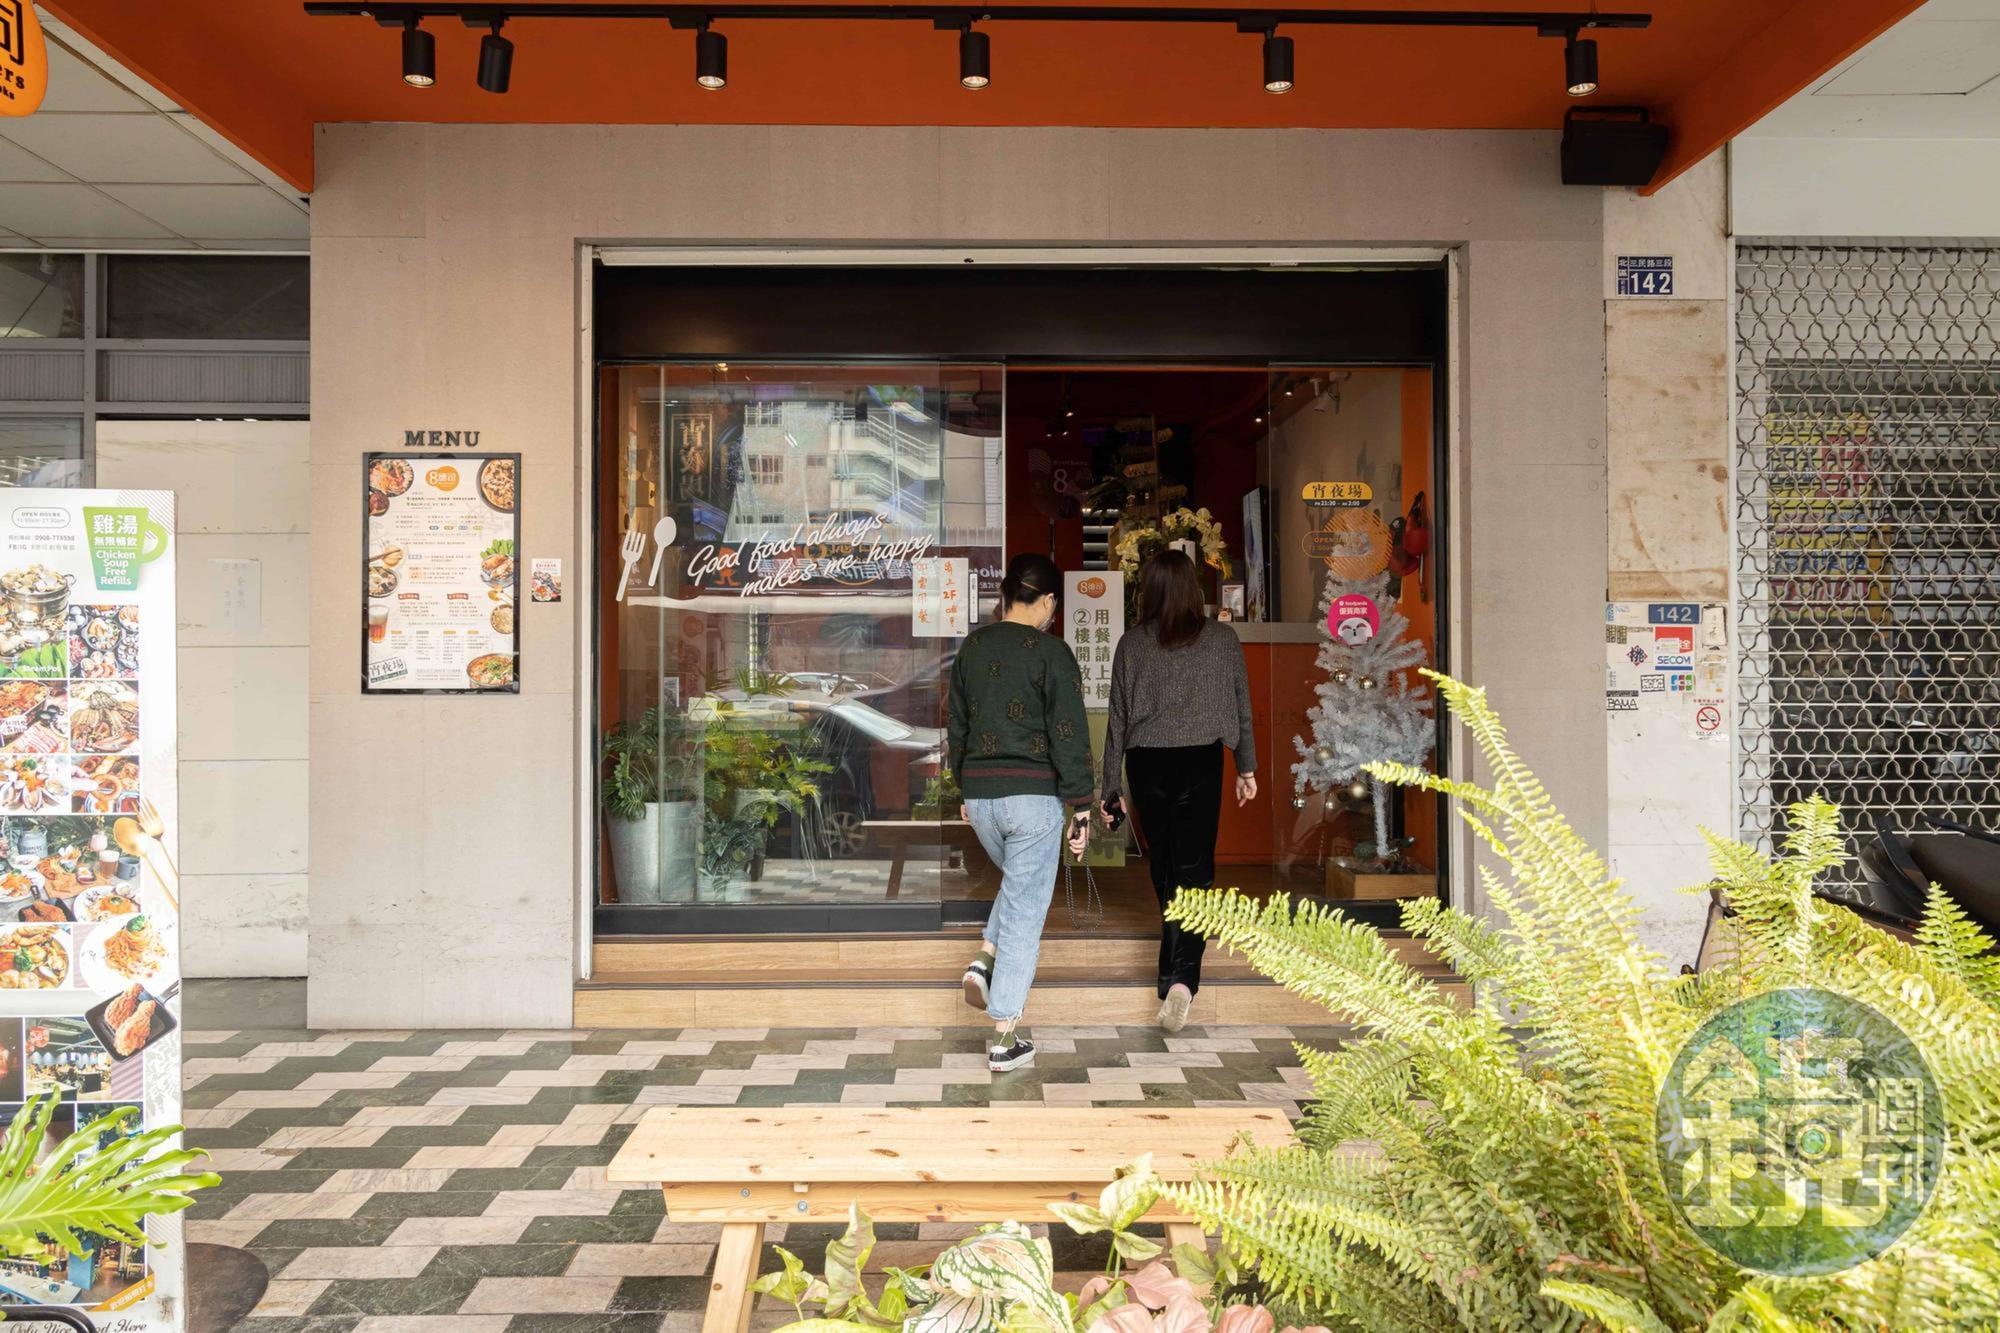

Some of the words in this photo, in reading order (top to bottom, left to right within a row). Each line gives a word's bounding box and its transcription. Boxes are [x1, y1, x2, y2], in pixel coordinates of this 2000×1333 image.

[1630, 259, 1672, 267] 三民路三段
[1631, 272, 1670, 293] 142
[404, 430, 480, 447] MENU
[1312, 483, 1362, 498] 宵夜場
[93, 514, 138, 534] 雞湯
[96, 551, 136, 559] Chicken
[687, 538, 749, 586] Good
[749, 522, 804, 573] food
[806, 512, 889, 547] always
[103, 558, 129, 568] Soup
[740, 558, 821, 598] makes
[824, 554, 854, 577] me
[868, 531, 936, 570] happy
[105, 568, 127, 576] Free
[100, 576, 131, 585] Refills
[1657, 606, 1692, 621] 142
[1095, 609, 1110, 700] 用餐請上樓
[1657, 656, 1691, 664] SECOM
[114, 1319, 148, 1332] Here
